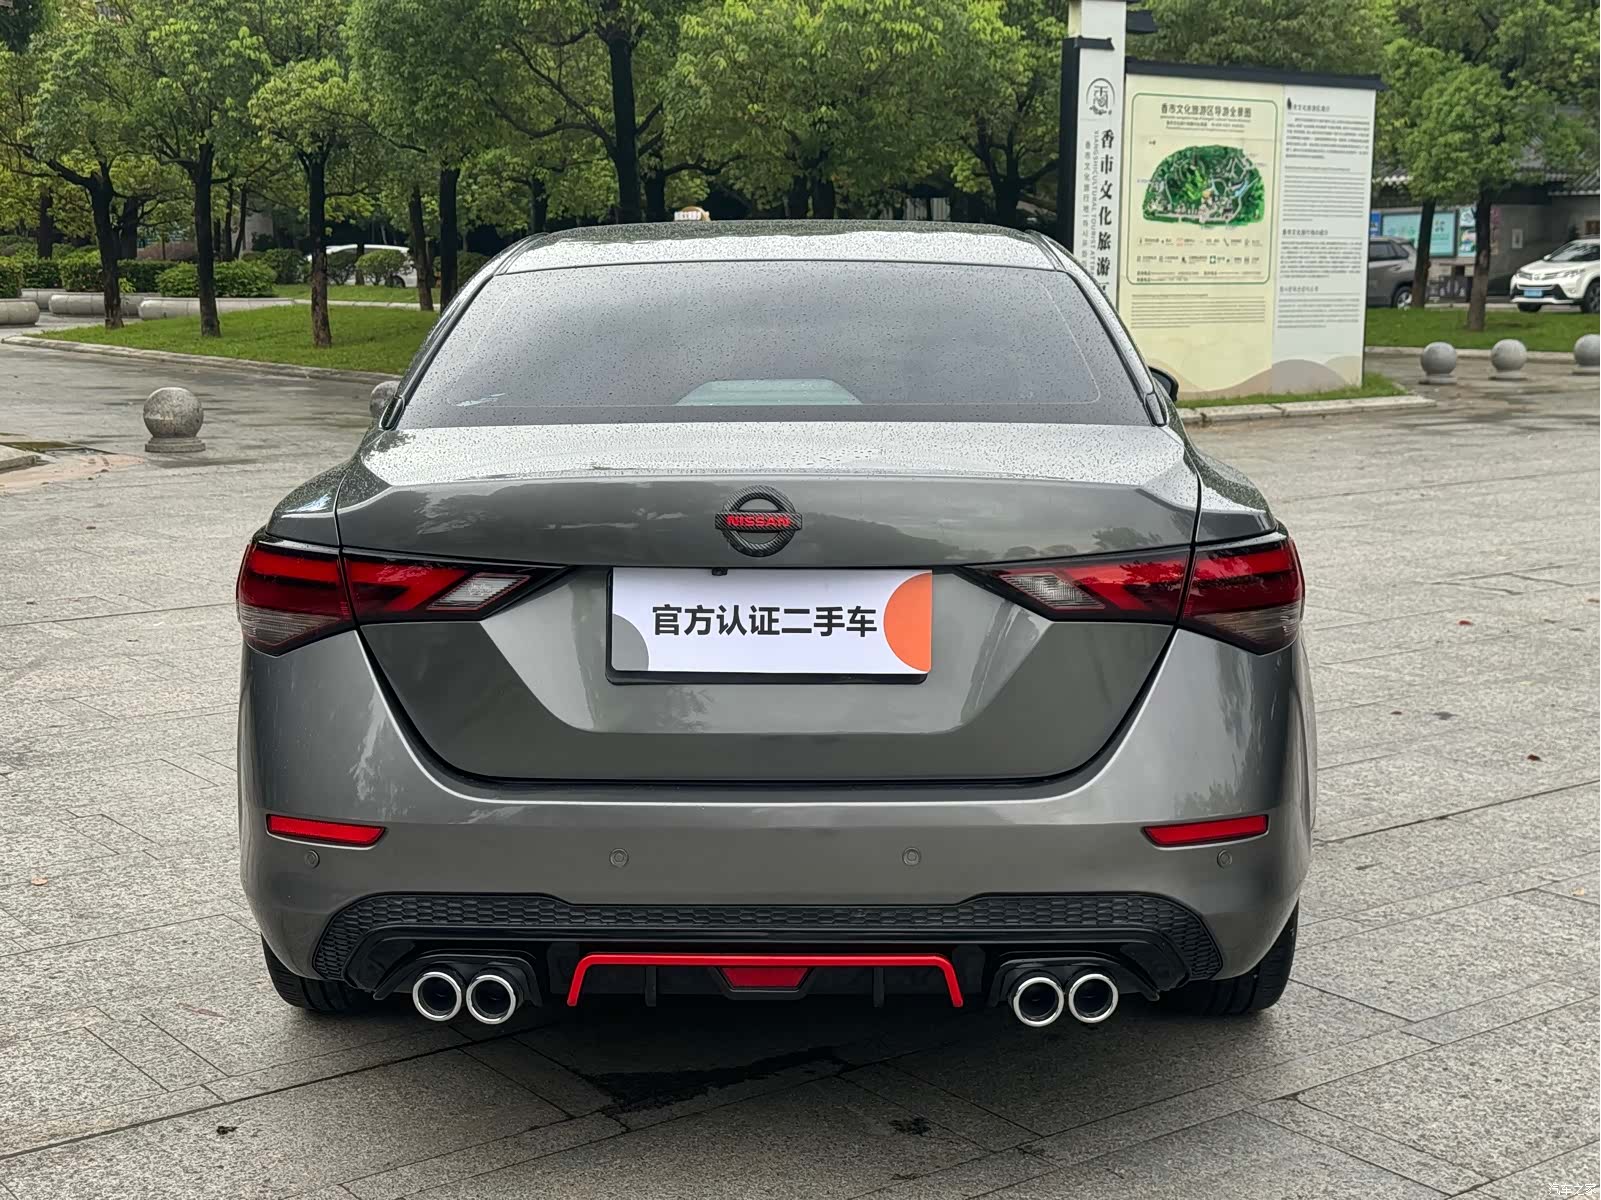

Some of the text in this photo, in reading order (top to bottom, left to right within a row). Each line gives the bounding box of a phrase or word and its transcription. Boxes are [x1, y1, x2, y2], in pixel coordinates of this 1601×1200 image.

[726, 514, 791, 527] NISSAN
[652, 604, 877, 637] 官方认证二手车
